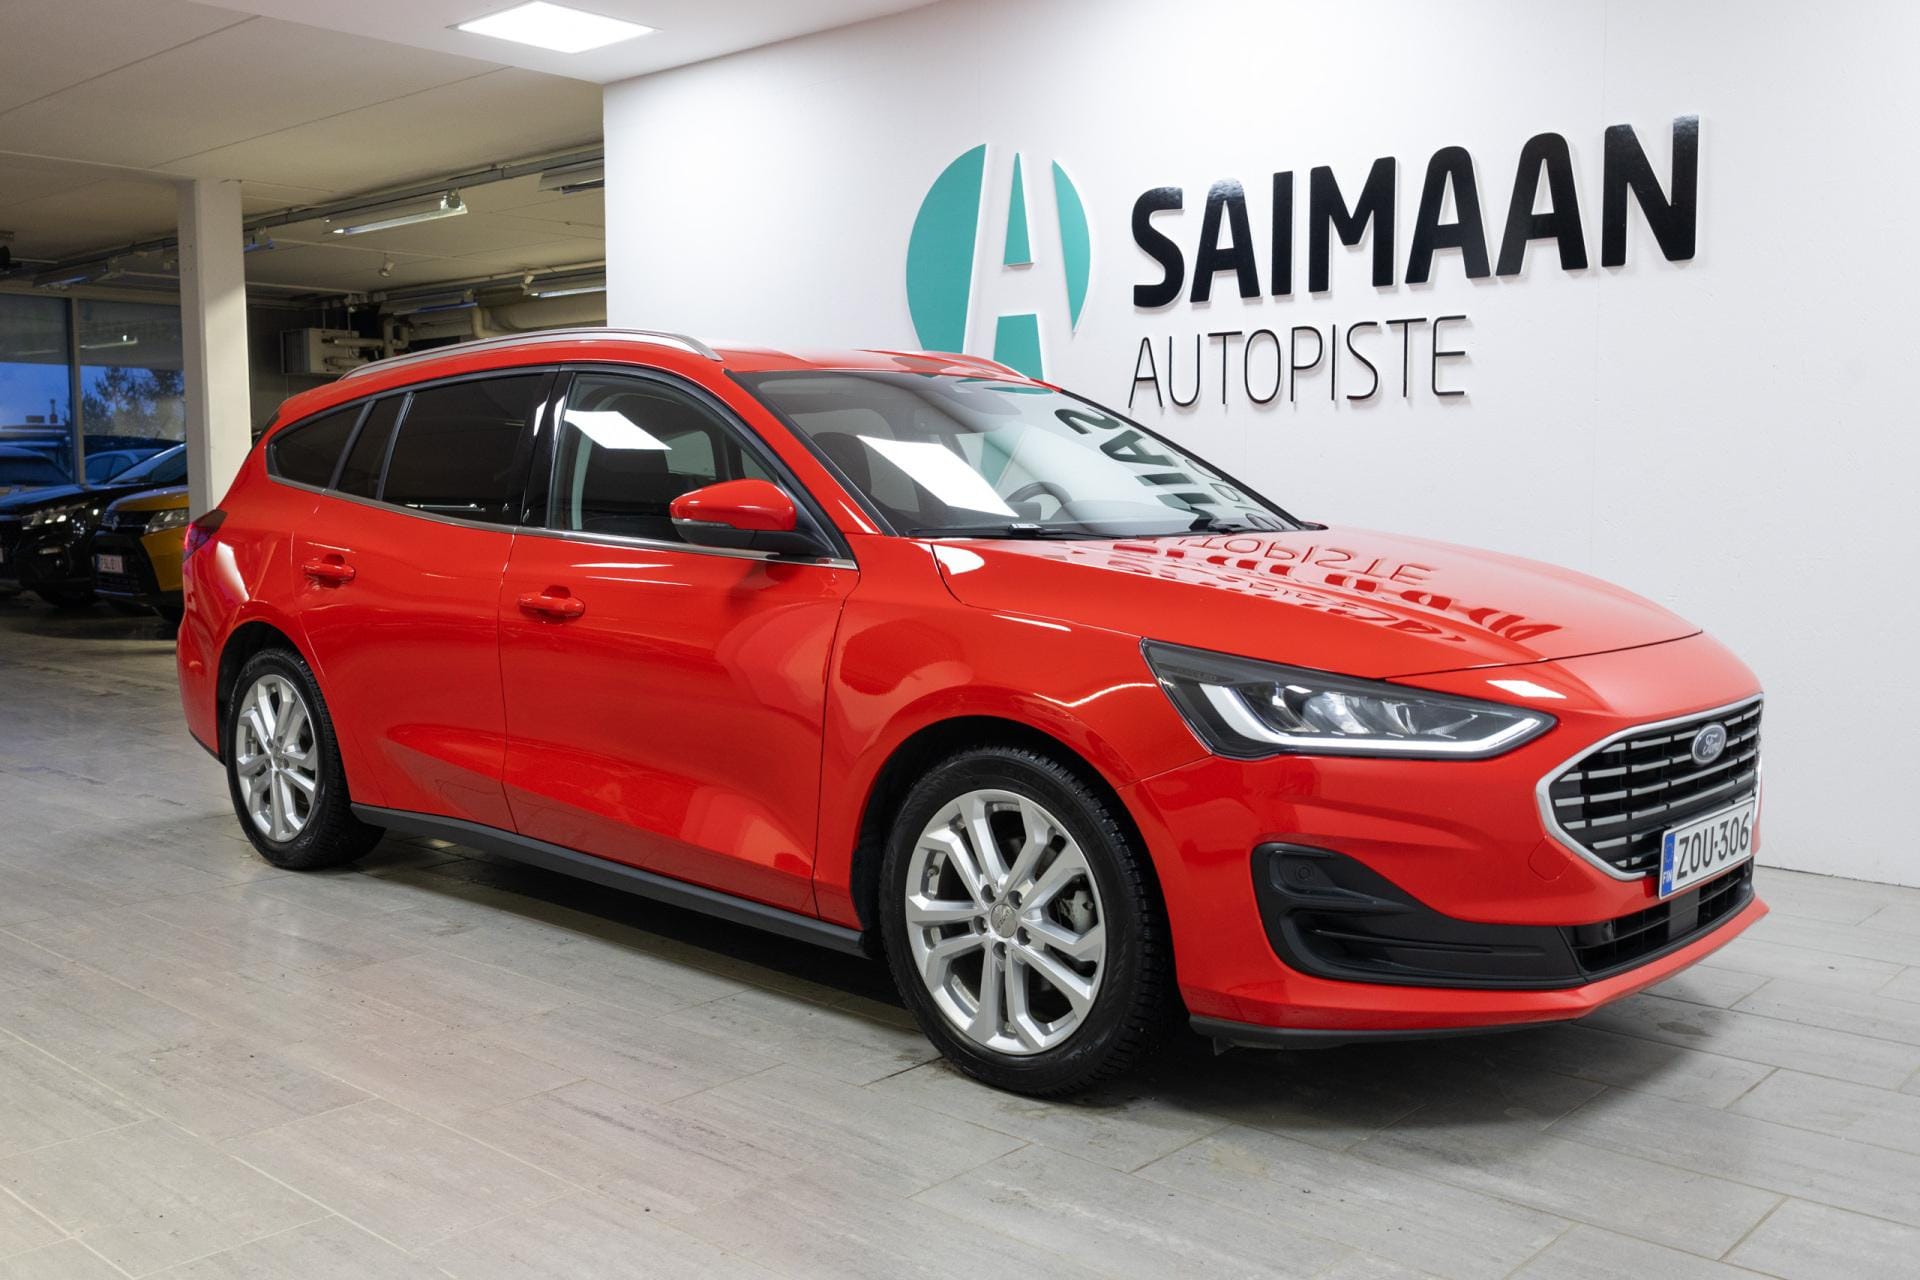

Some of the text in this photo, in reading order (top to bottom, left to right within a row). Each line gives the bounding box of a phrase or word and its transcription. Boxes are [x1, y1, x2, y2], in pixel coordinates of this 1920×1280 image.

[1132, 115, 1699, 307] SAIMAAN
[1129, 315, 1467, 409] AUTOPISTE
[1676, 811, 1750, 880] ZOU-306
